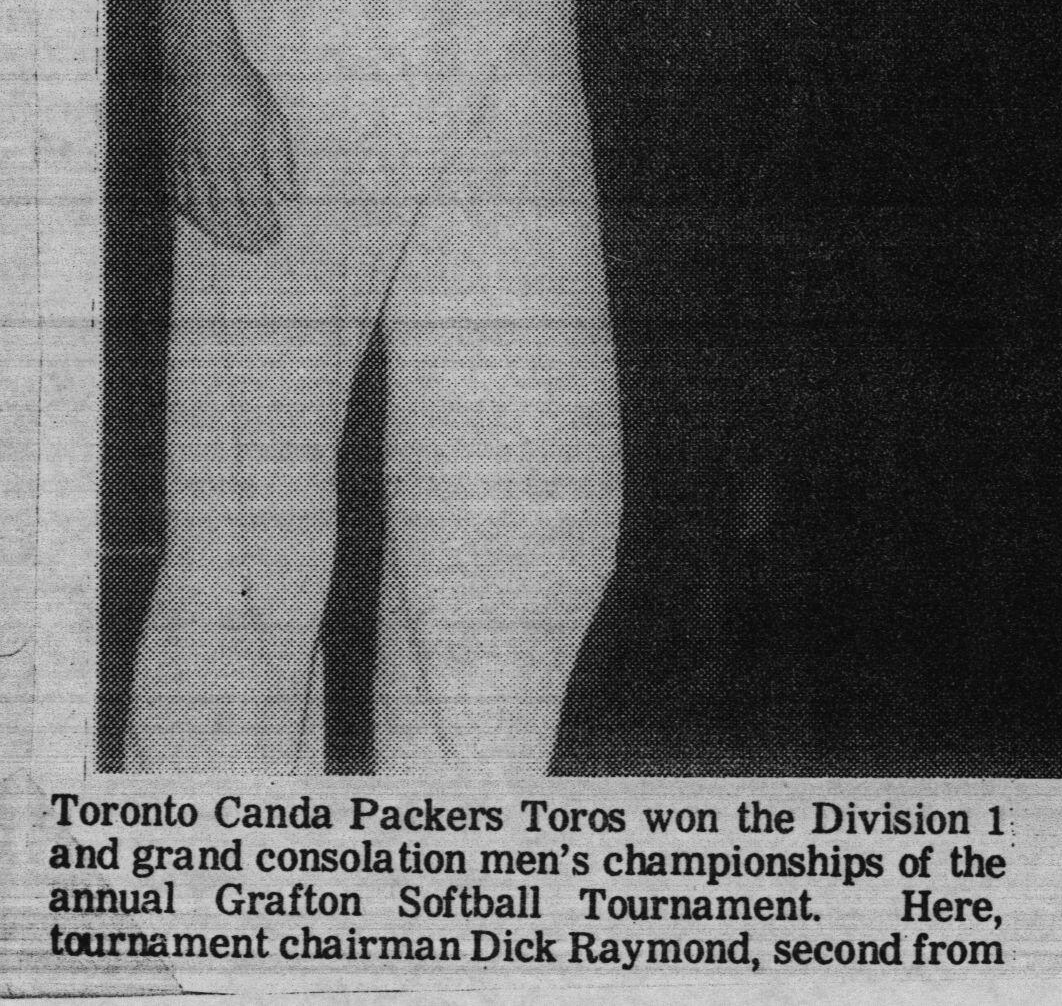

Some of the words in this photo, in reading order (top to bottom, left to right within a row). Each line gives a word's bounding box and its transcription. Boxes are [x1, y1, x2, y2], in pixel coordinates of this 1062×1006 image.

[51, 794, 197, 828] Toronto
[215, 796, 332, 830] Canda
[350, 798, 503, 832] Packers
[521, 801, 625, 833] Toros
[644, 809, 718, 833] won
[738, 801, 794, 834] the
[812, 802, 969, 835] Division
[988, 806, 1004, 835] 1
[50, 838, 120, 870] and
[133, 839, 242, 878] grand
[257, 840, 466, 874] consolation
[604, 844, 883, 885] championships
[898, 846, 937, 877] of
[951, 845, 1006, 878] the
[49, 881, 174, 915] annual
[216, 883, 361, 917] Grafton
[399, 886, 541, 919] Softball
[580, 889, 821, 922] Tournament.
[901, 890, 1002, 929] Here,
[51, 924, 268, 959] tournament
[280, 927, 460, 960] chairman
[471, 930, 556, 962] Dick
[569, 932, 760, 971] Raymond,
[775, 933, 902, 966] second
[913, 933, 1004, 966] from
